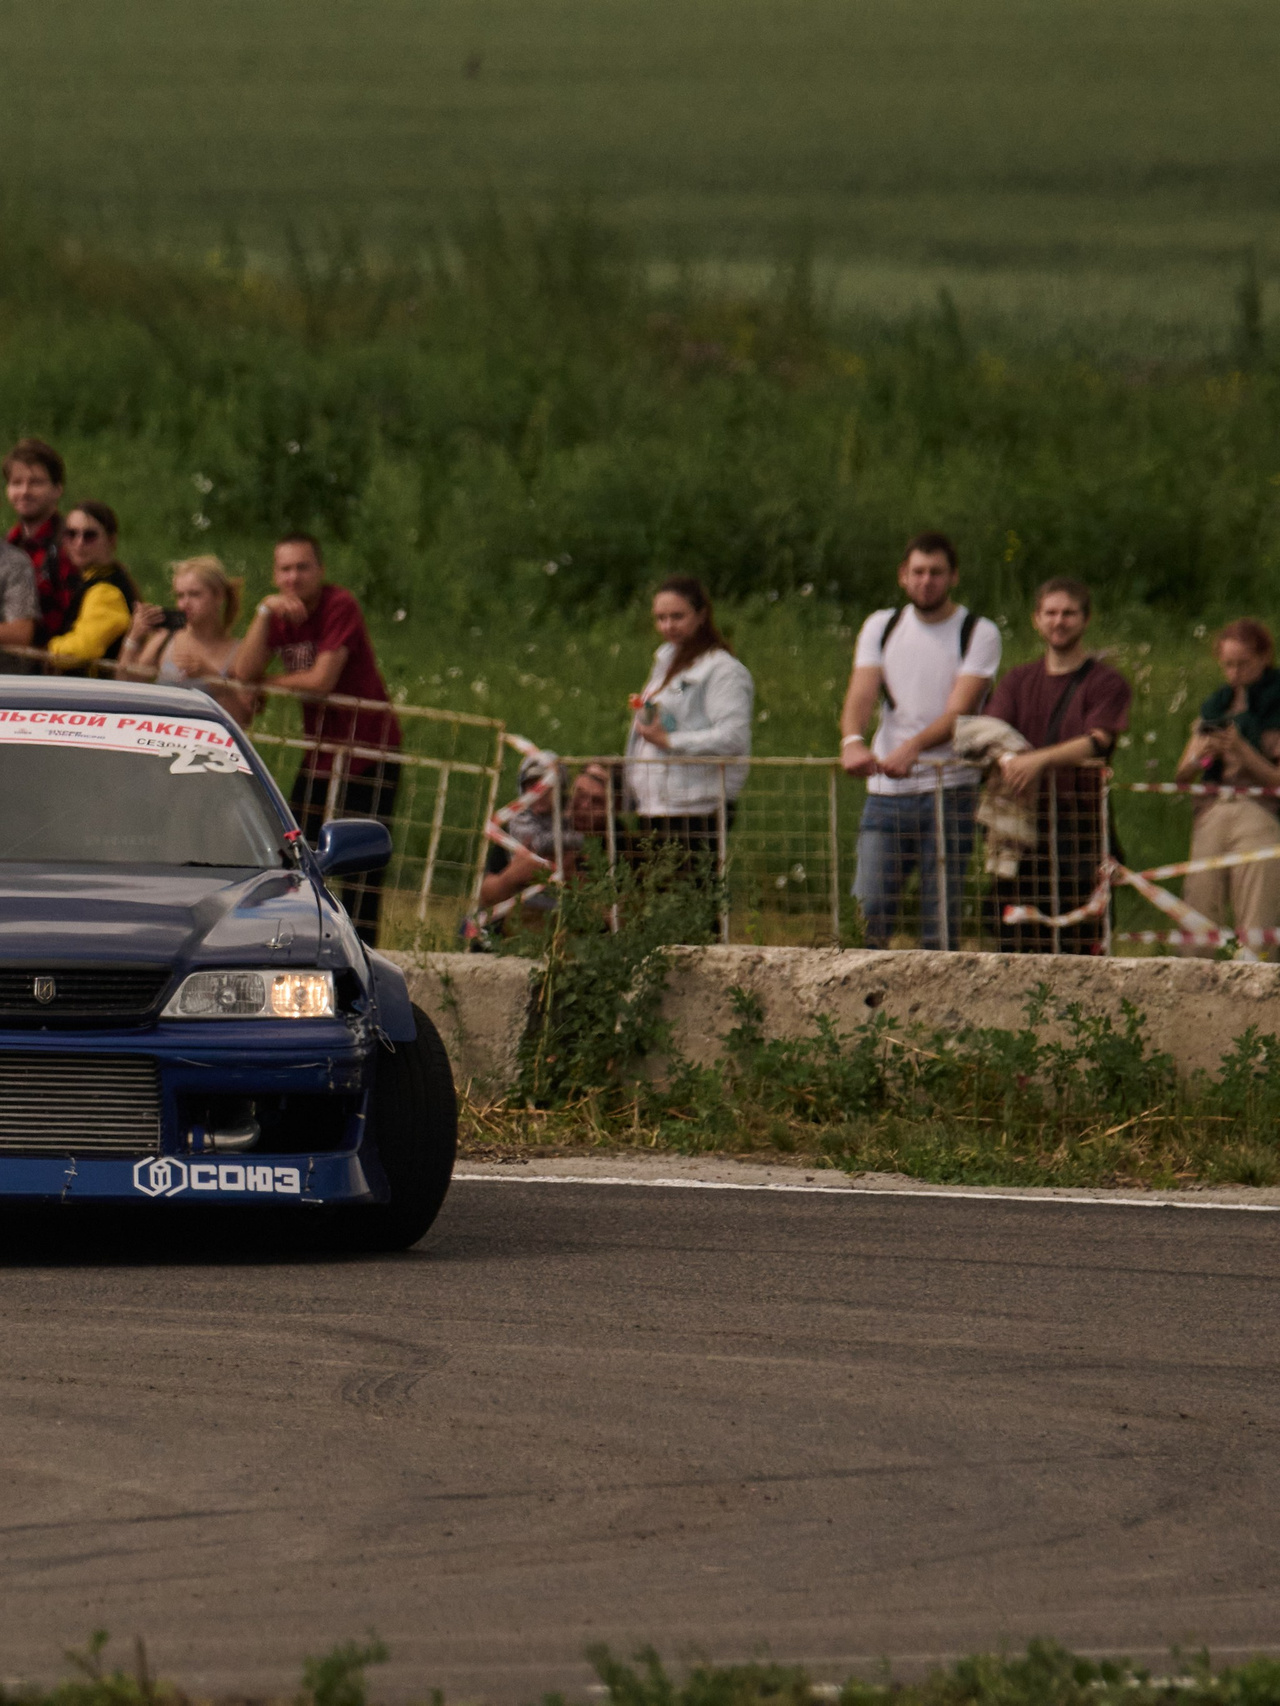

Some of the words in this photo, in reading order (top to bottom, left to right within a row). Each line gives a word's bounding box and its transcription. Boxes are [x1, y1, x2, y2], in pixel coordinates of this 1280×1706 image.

[116, 717, 236, 748] РАКЕТЫ
[158, 746, 238, 775] 23
[189, 1163, 301, 1194] СОЮЗ
